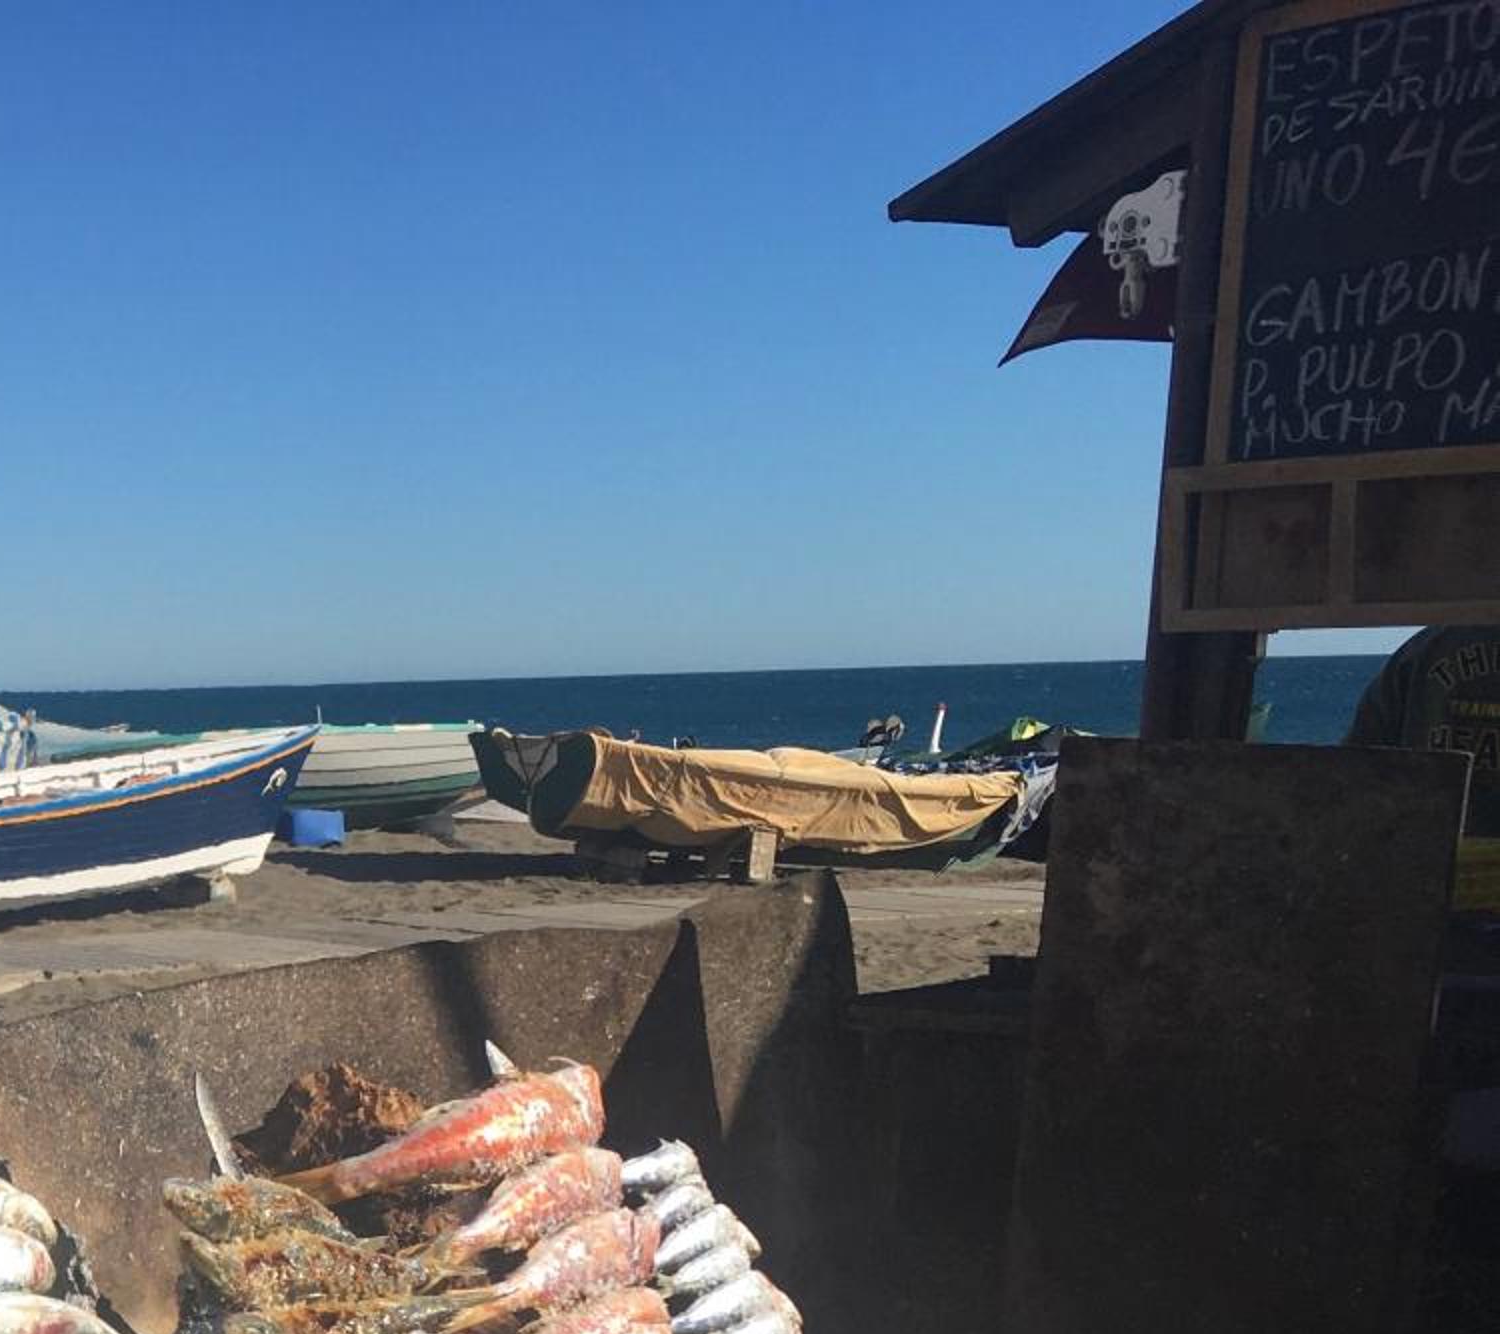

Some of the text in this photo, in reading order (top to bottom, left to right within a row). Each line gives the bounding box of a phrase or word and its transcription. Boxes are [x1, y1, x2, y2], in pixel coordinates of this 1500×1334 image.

[1262, 98, 1319, 157] DE
[1254, 144, 1365, 219] UNO
[1298, 328, 1466, 404] PULPO
[1243, 399, 1406, 460] MUCHO
